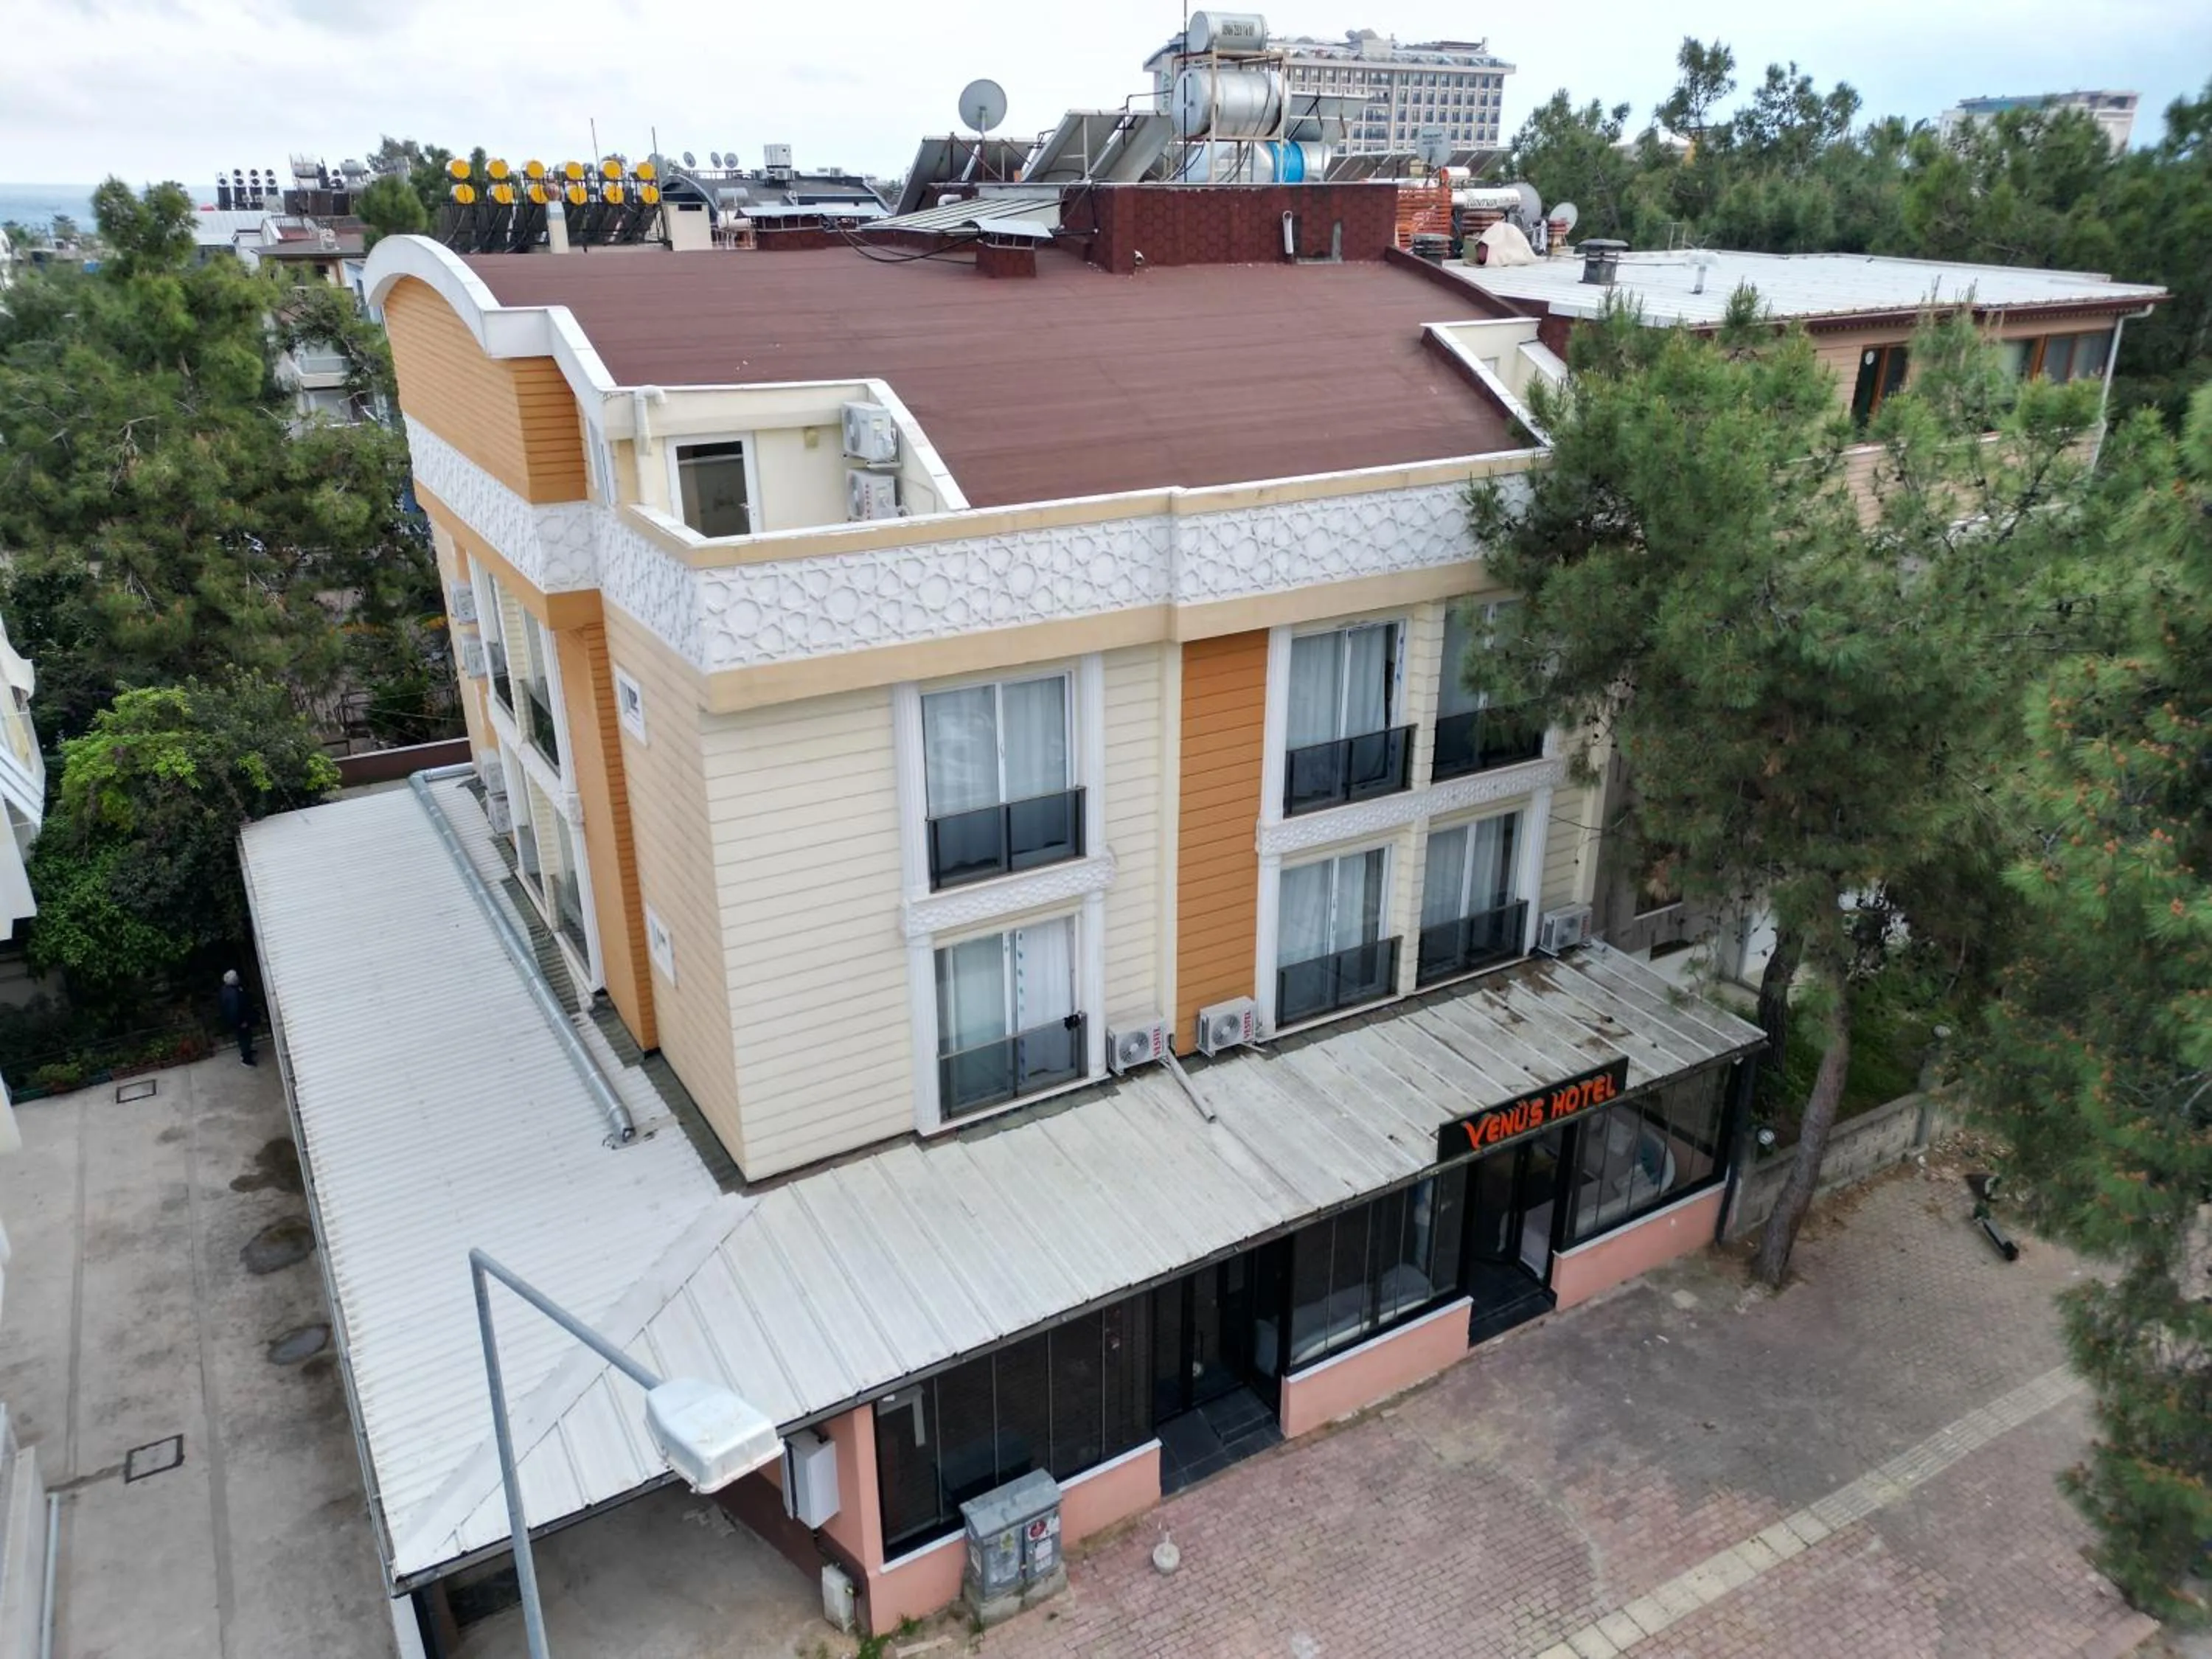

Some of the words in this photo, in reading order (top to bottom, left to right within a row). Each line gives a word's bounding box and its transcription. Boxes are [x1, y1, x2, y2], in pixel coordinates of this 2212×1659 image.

[1243, 1010, 1251, 1039] VESTEL
[1152, 1027, 1161, 1058] VESTEL
[1551, 1073, 1615, 1119] HOTEL
